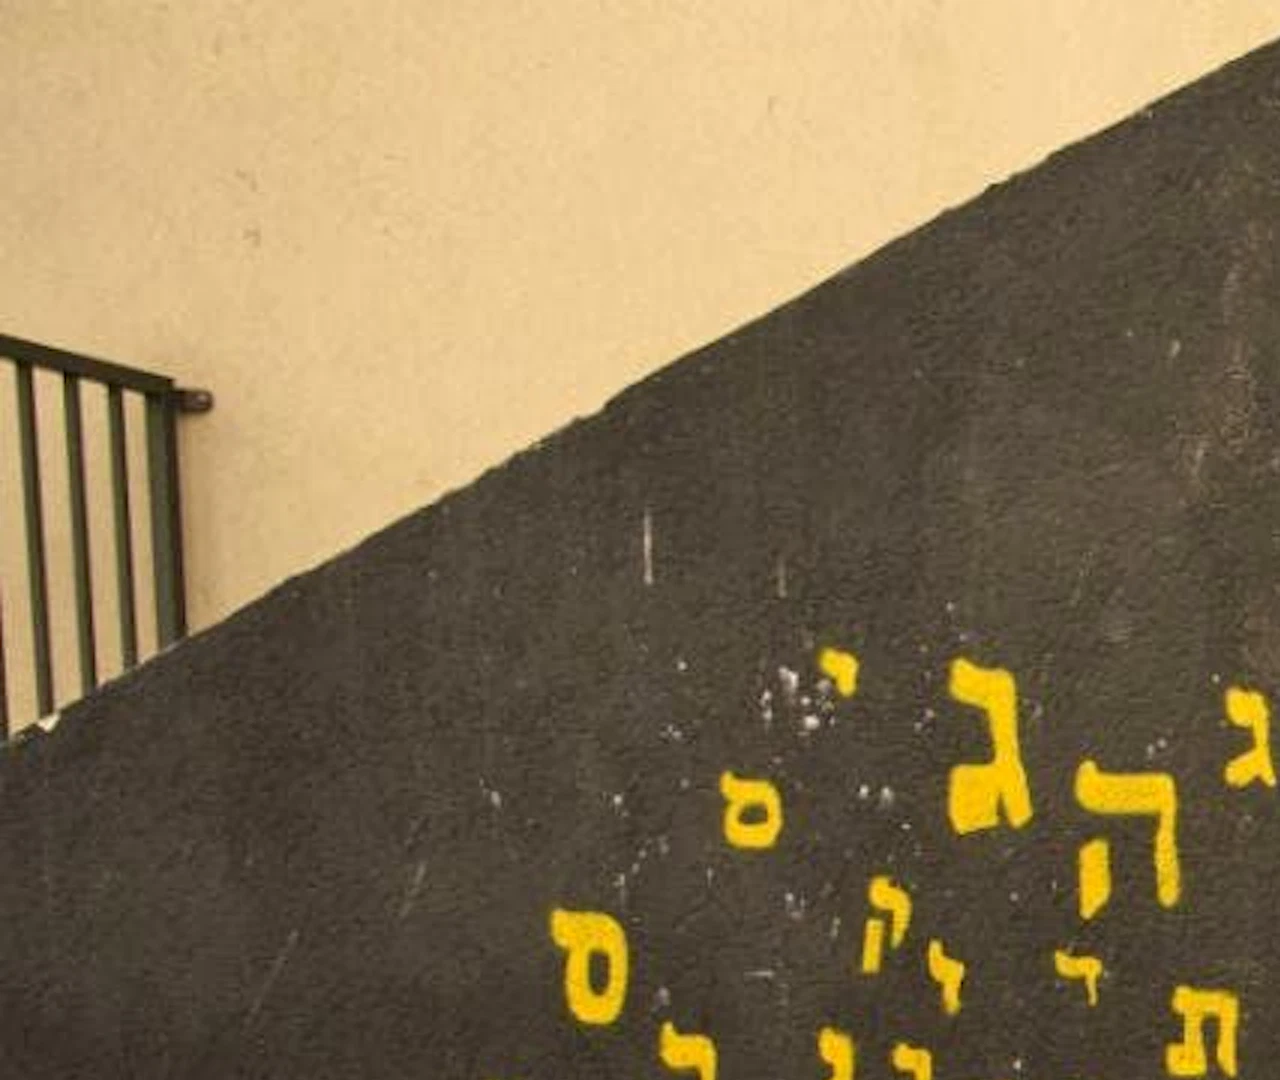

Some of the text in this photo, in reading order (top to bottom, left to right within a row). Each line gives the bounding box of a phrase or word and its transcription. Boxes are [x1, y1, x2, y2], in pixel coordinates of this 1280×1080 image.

[945, 655, 1035, 836] ג
[1222, 684, 1278, 790] ג
[1072, 758, 1184, 921] ה
